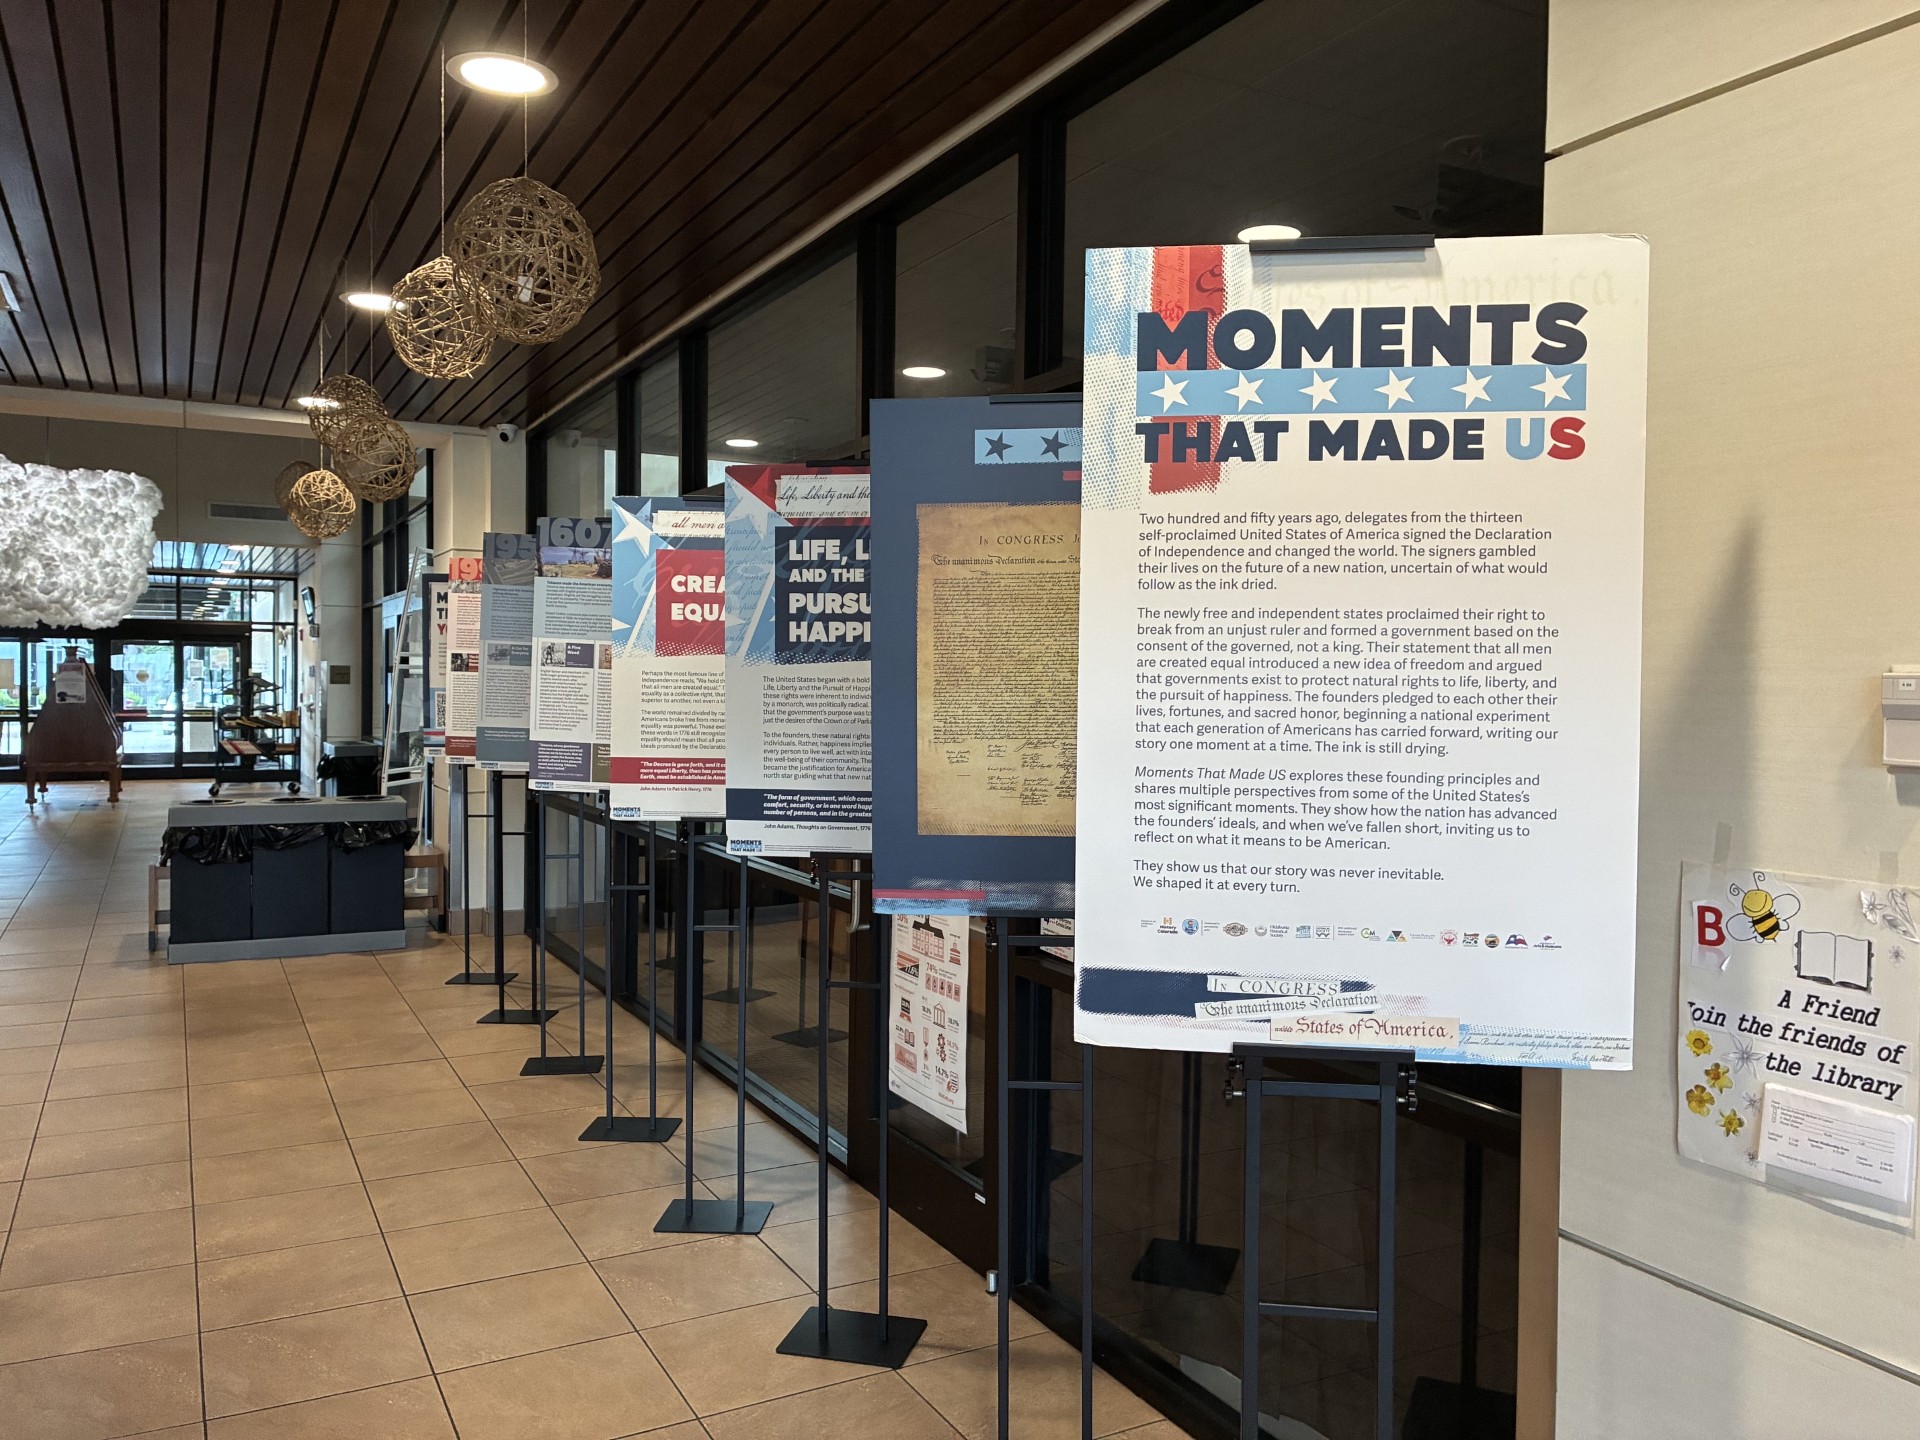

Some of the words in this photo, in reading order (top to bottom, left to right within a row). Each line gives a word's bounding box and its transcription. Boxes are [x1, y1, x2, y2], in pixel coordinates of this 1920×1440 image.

[1137, 302, 1587, 372] MOMENTS
[1136, 421, 1288, 463] THAT
[1308, 419, 1484, 461] MADE
[1506, 418, 1585, 461] US
[801, 485, 836, 506] Liberty
[837, 486, 856, 499] and
[672, 517, 690, 528] all
[1139, 512, 1164, 523] Two
[1168, 512, 1220, 524] hundred
[1224, 512, 1246, 523] and
[1250, 512, 1275, 526] fifty
[1278, 515, 1312, 526] years
[1316, 515, 1341, 526] ago,
[1345, 511, 1407, 526] delegates
[1411, 511, 1441, 523] from
[1445, 511, 1466, 522] the
[1470, 511, 1522, 523] thirteen
[1139, 528, 1236, 543] self-proclaimed
[1240, 528, 1282, 540] United
[1286, 529, 1326, 540] States
[1330, 528, 1343, 539] of
[1346, 528, 1400, 539] America
[1403, 528, 1446, 543] signed
[1450, 528, 1471, 539] the
[1476, 528, 1552, 540] Declaration
[789, 539, 847, 565] LIFE,
[856, 539, 871, 560] L
[952, 557, 993, 565] unanimous
[988, 554, 1036, 564] Declaration
[1139, 546, 1152, 557] of
[1155, 545, 1244, 559] Independence
[1248, 545, 1271, 556] and
[1275, 545, 1330, 559] changed
[1334, 545, 1355, 556] the
[1358, 545, 1398, 556] world.
[1401, 545, 1425, 556] The
[1429, 545, 1476, 559] signers
[1479, 545, 1536, 559] gambled
[789, 569, 827, 582] AND
[831, 569, 864, 582] THE
[789, 621, 871, 642] HAPPI
[1134, 860, 1163, 874] They
[1167, 862, 1200, 873] show
[1204, 865, 1217, 873] us
[1221, 862, 1247, 874] that
[1251, 866, 1272, 875] our
[1275, 865, 1307, 879] story
[1310, 868, 1335, 877] was
[1340, 869, 1375, 878] never
[1379, 868, 1444, 880] inevitable.
[1133, 876, 1152, 887] We
[1156, 877, 1201, 891] shaped
[1206, 878, 1214, 889] it
[1217, 880, 1230, 890] at
[1233, 882, 1267, 894] every
[1270, 882, 1300, 892] turn.
[1697, 905, 1726, 948] B
[1239, 980, 1339, 995] CONGRESS
[1200, 1003, 1232, 1016] The
[1236, 1000, 1306, 1015] unanimous
[1298, 994, 1378, 1010] Declaration
[1777, 990, 1792, 1009] A
[1801, 993, 1881, 1028] Friend
[1296, 1017, 1344, 1034] States
[1349, 1018, 1363, 1040] of
[1738, 1013, 1773, 1038] the
[1778, 1021, 1866, 1057] friends
[1877, 1043, 1906, 1066] of
[1765, 1051, 1802, 1077] the
[1811, 1062, 1903, 1102] library
